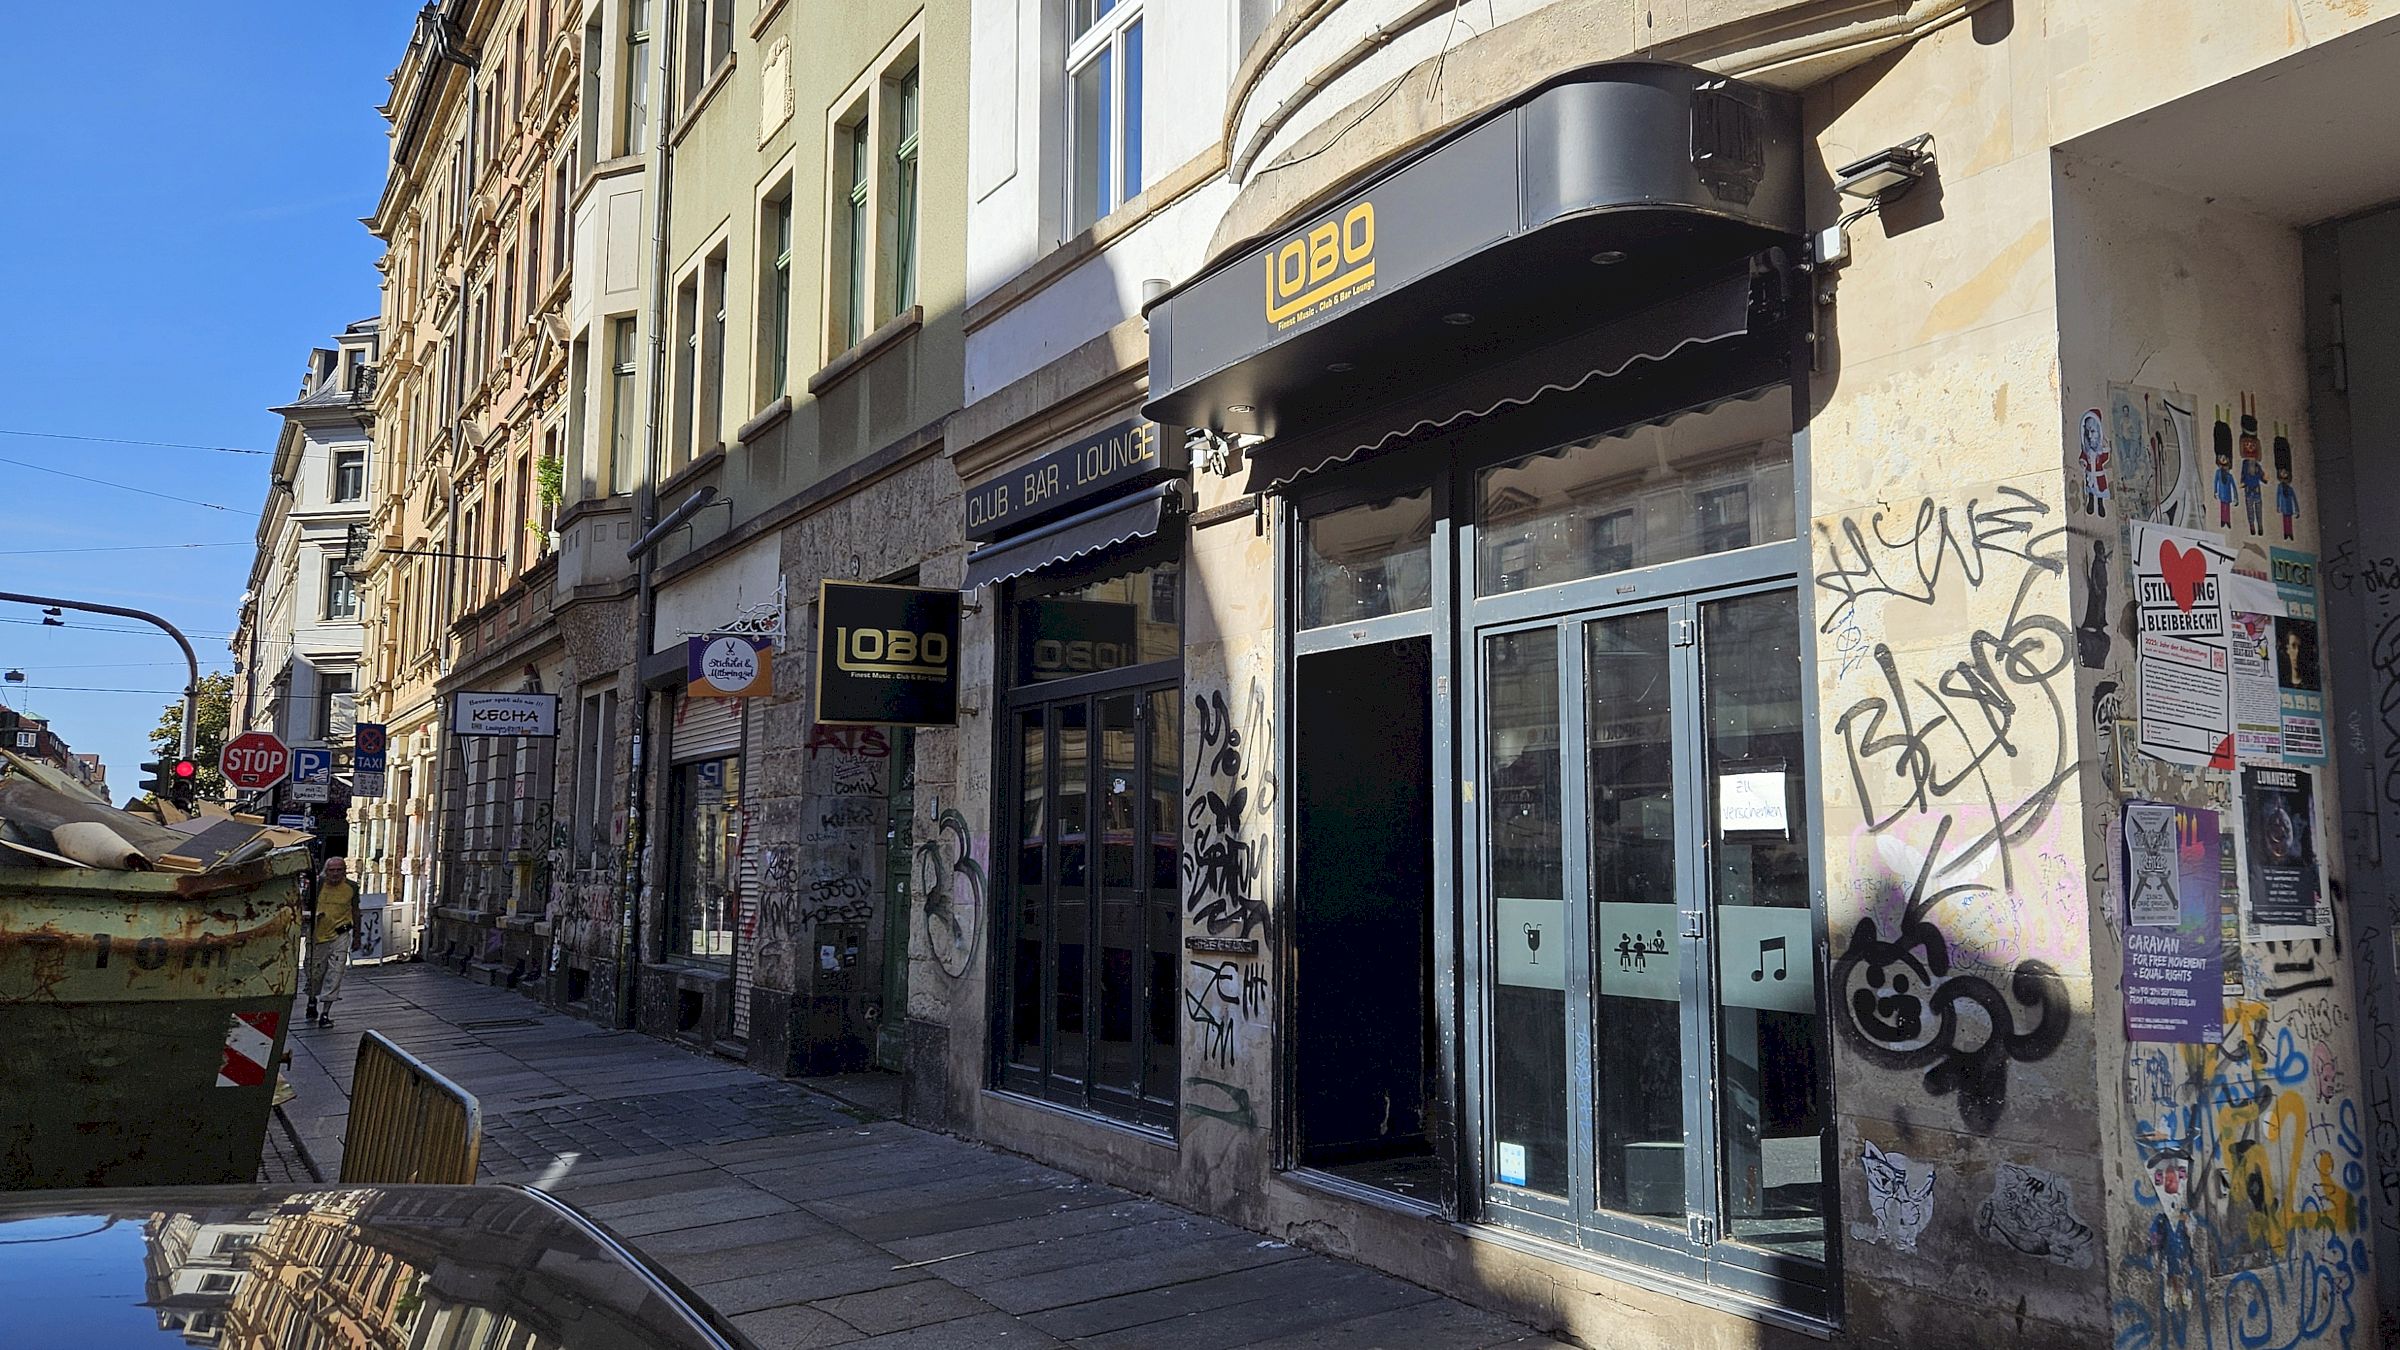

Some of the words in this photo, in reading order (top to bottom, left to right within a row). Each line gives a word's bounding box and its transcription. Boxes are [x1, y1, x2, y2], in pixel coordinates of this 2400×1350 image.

[1265, 202, 1376, 324] LOBO
[1277, 316, 1296, 331] Finest
[1297, 308, 1315, 323] Music
[1319, 298, 1333, 311] Club
[1333, 295, 1340, 305] &
[1340, 289, 1352, 302] Bar
[1352, 279, 1375, 296] Lounge
[969, 485, 1009, 528] CLUB
[1024, 464, 1059, 507] BAR
[1077, 422, 1154, 486] LOUNGE
[2147, 613, 2218, 631] BLEIBERECHT
[837, 627, 948, 675] LOBO
[744, 658, 754, 668] &
[850, 671, 871, 679] Finest
[472, 709, 539, 723] KECHA
[226, 748, 283, 773] STOP
[299, 753, 320, 779] P
[357, 756, 383, 769] TAXI
[2256, 770, 2297, 788] LUNAVERSE
[2128, 934, 2180, 954] CARAVAN
[2132, 953, 2148, 967] FOR
[2149, 954, 2168, 967] FREE
[2168, 956, 2207, 970] MOVEMENT
[2138, 968, 2164, 980] EQUAL
[2165, 969, 2192, 982] RIGHTS
